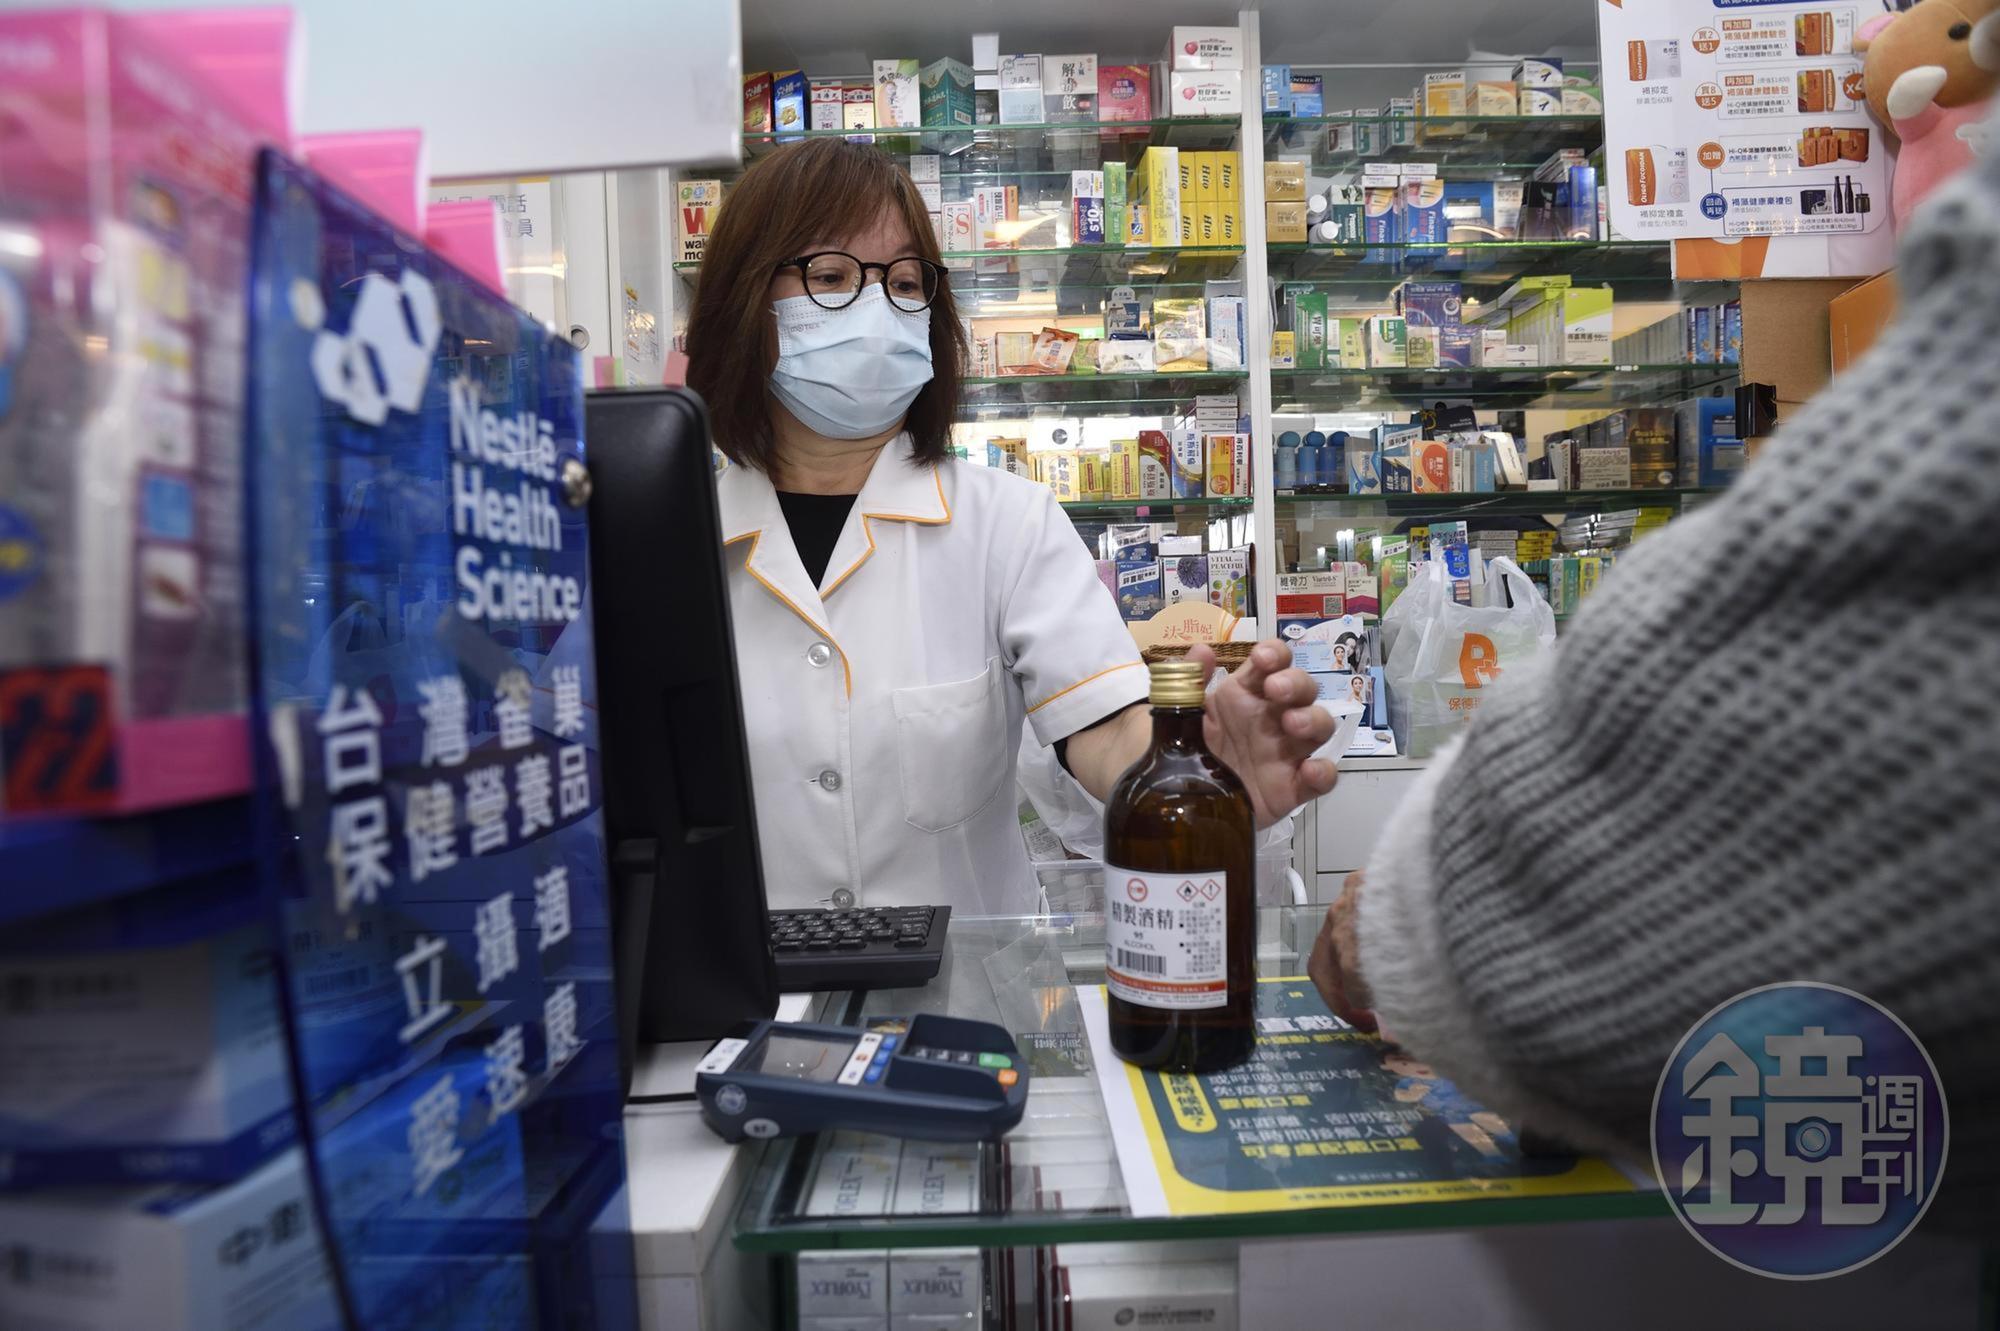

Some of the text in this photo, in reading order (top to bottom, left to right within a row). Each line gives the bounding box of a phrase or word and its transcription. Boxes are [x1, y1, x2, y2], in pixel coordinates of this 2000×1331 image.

[1698, 30, 1713, 39] 買2
[1701, 86, 1716, 95] 買8
[449, 374, 557, 482] Nestlé
[452, 460, 562, 551] Health
[456, 544, 580, 623] Science
[1280, 574, 1308, 588] 維骨力
[316, 664, 586, 797] 台灣雀巢
[325, 743, 591, 905] 保健營養品
[1112, 900, 1174, 930] 精製酒精
